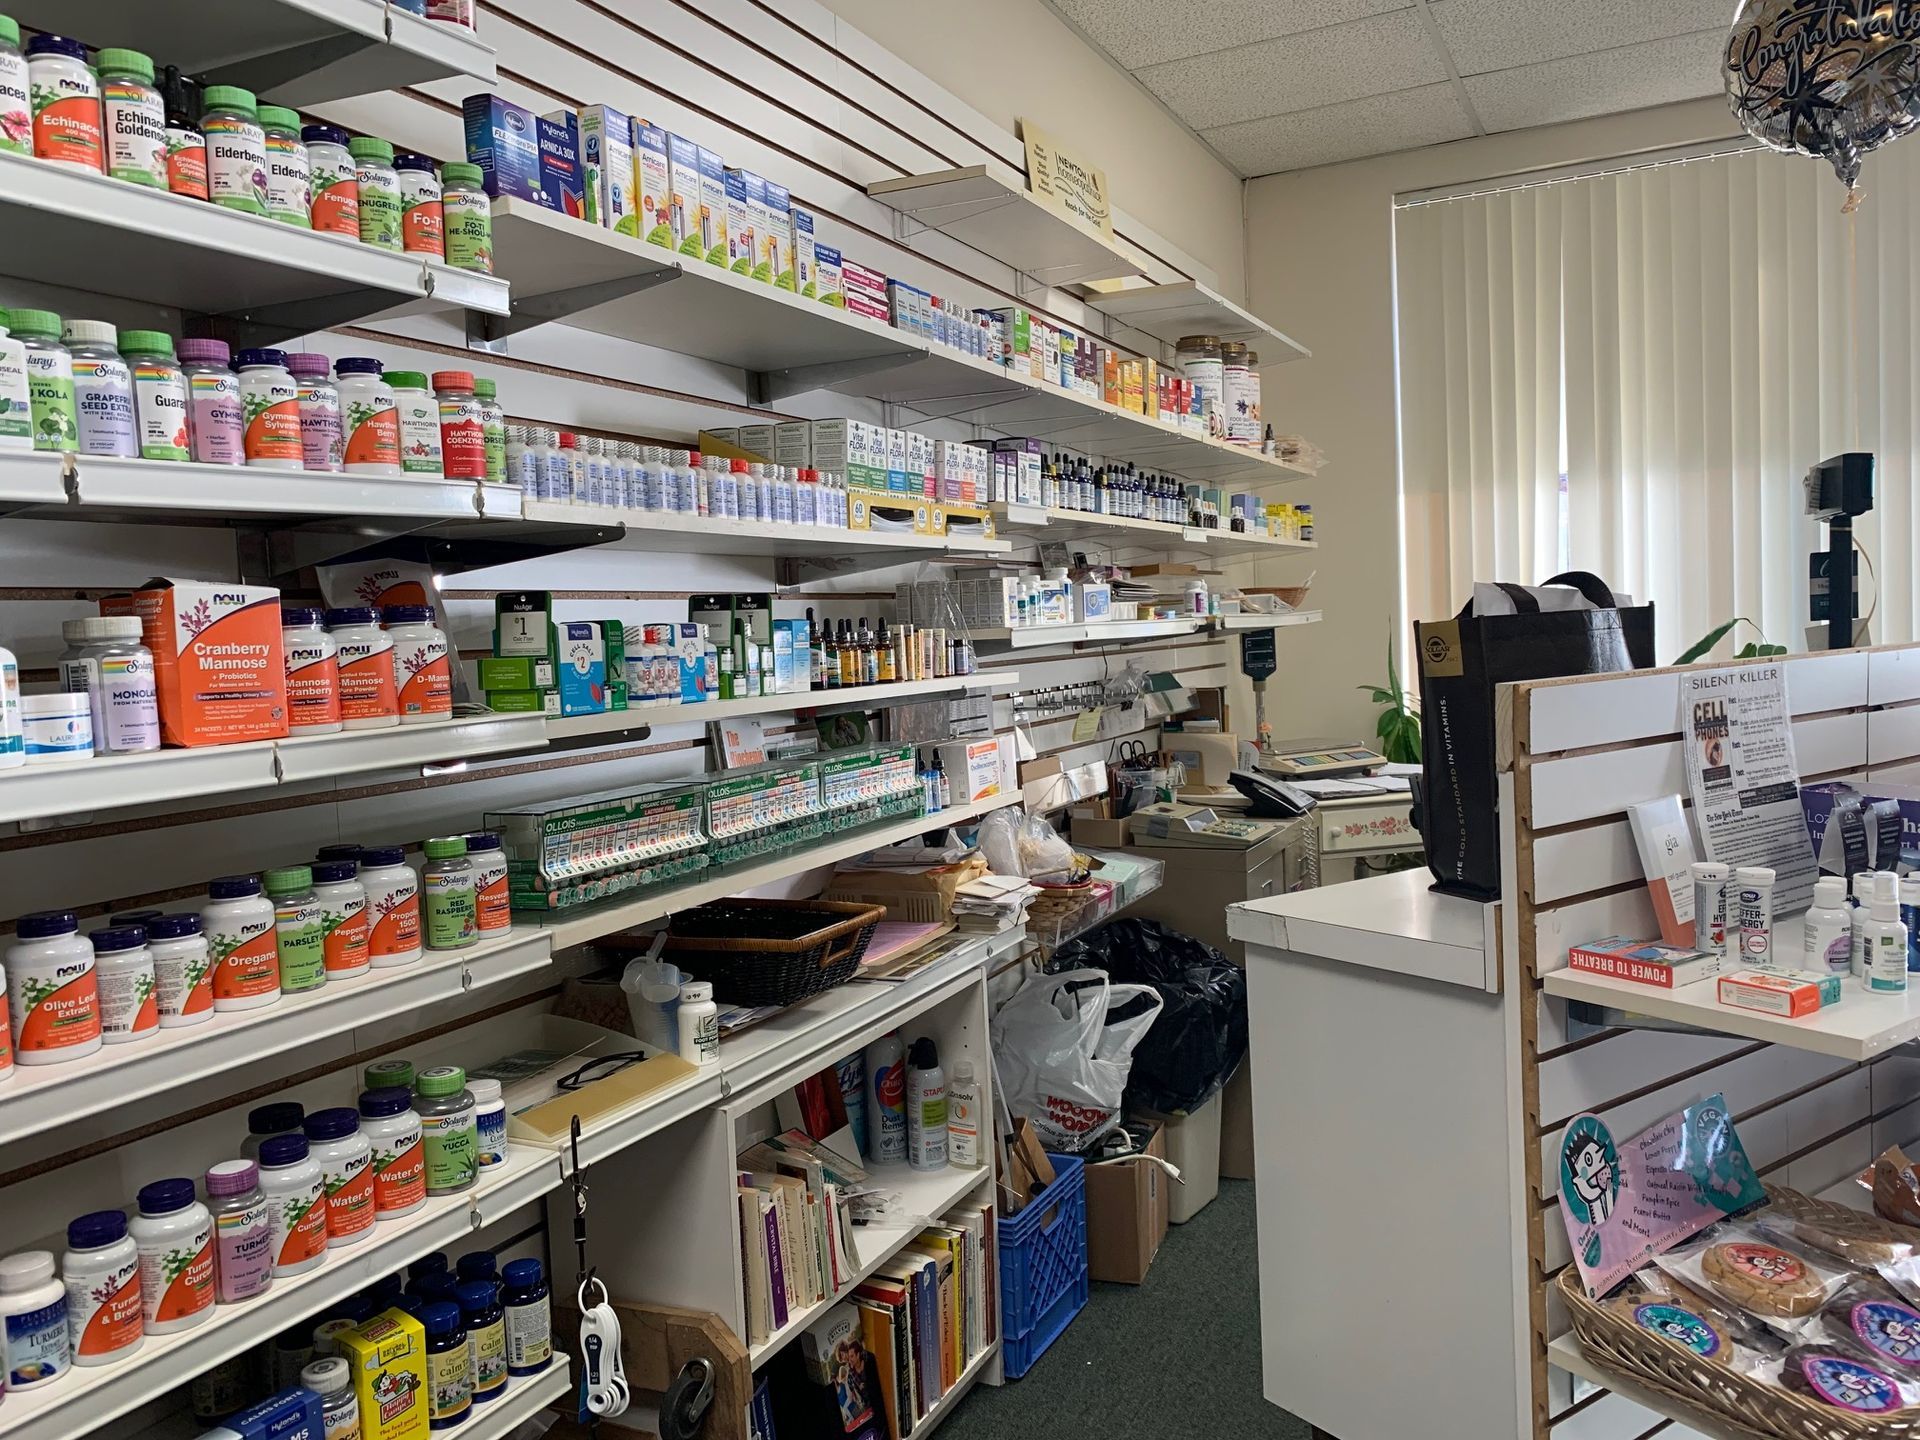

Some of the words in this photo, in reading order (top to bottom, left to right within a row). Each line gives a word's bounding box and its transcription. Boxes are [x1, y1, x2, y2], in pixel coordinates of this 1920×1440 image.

[59, 79, 89, 94] now
[542, 122, 569, 140] Hyland's
[540, 138, 563, 157] ARNICA
[563, 147, 576, 161] 30X
[1058, 154, 1087, 180] NEWTON
[419, 188, 439, 199] now
[38, 389, 68, 400] KOLA
[271, 387, 294, 397] now
[81, 402, 108, 410] SEED
[402, 420, 438, 428] HAWTHORN
[849, 441, 866, 450] FLORA
[869, 446, 885, 455] FLORA
[889, 449, 904, 458] FLORA
[909, 451, 924, 460] FLORA
[946, 460, 960, 468] FLORA
[962, 462, 975, 470] FLORA
[975, 464, 987, 472] FLORA
[855, 503, 863, 514] 60
[374, 570, 399, 581] now
[213, 594, 246, 606] now
[194, 642, 270, 656] Cranberry
[292, 649, 322, 661] now
[340, 645, 370, 656] now
[570, 643, 581, 658] CELL
[582, 643, 594, 657] SALT
[199, 657, 267, 670] Mannose
[219, 672, 257, 680] Probiotics
[1692, 674, 1736, 690] SILENT
[1740, 669, 1778, 684] KILLER
[1693, 700, 1728, 723] CELL
[1440, 696, 1452, 750] VITAMINS.
[1695, 726, 1729, 742] PHONES
[1448, 753, 1455, 765] IN
[824, 763, 843, 774] OLLOIS
[708, 786, 731, 799] OLLOIS
[1450, 767, 1466, 825] STANDARD
[545, 818, 576, 833] OLLOIS
[489, 868, 506, 877] now
[1456, 860, 1464, 881] THE
[440, 875, 469, 887] Solaray
[395, 886, 415, 898] now
[344, 899, 364, 911] now
[241, 923, 267, 935] now
[399, 918, 416, 929] 1500
[284, 936, 319, 948] PARSLEY
[350, 932, 365, 942] Gels
[228, 951, 277, 967] Oregano
[1572, 952, 1614, 972] BREATHE
[56, 963, 86, 978] now
[1617, 961, 1629, 975] TO
[1631, 964, 1667, 983] POWER
[43, 998, 76, 1012] Olive
[58, 1004, 91, 1018] Extract
[439, 1115, 470, 1130] Solaray
[881, 1115, 900, 1123] Dust
[395, 1132, 419, 1149] now
[442, 1138, 470, 1151] YUCCA
[345, 1154, 369, 1172] now
[380, 1168, 412, 1184] Water
[1646, 1180, 1668, 1190] Oatmeal
[1669, 1181, 1686, 1192] Raisin
[329, 1194, 362, 1209] Water
[1641, 1193, 1665, 1206] Pumpkin
[1666, 1196, 1680, 1208] Spice
[1633, 1207, 1651, 1219] Peanut
[1652, 1209, 1671, 1221] Butter
[1622, 1218, 1633, 1229] and
[769, 1223, 778, 1255] CRYSTAL
[118, 1261, 138, 1278] now
[772, 1255, 780, 1273] BIBLE
[102, 1315, 110, 1325] &
[481, 1339, 501, 1352] Calm
[901, 1330, 909, 1366] Phones
[440, 1366, 462, 1378] Calm
[385, 1393, 410, 1412] Happy
[240, 1408, 273, 1426] CALMS
[271, 1412, 300, 1431] Hyland's
[325, 1409, 355, 1428] Solaray
[379, 1426, 390, 1437] The
